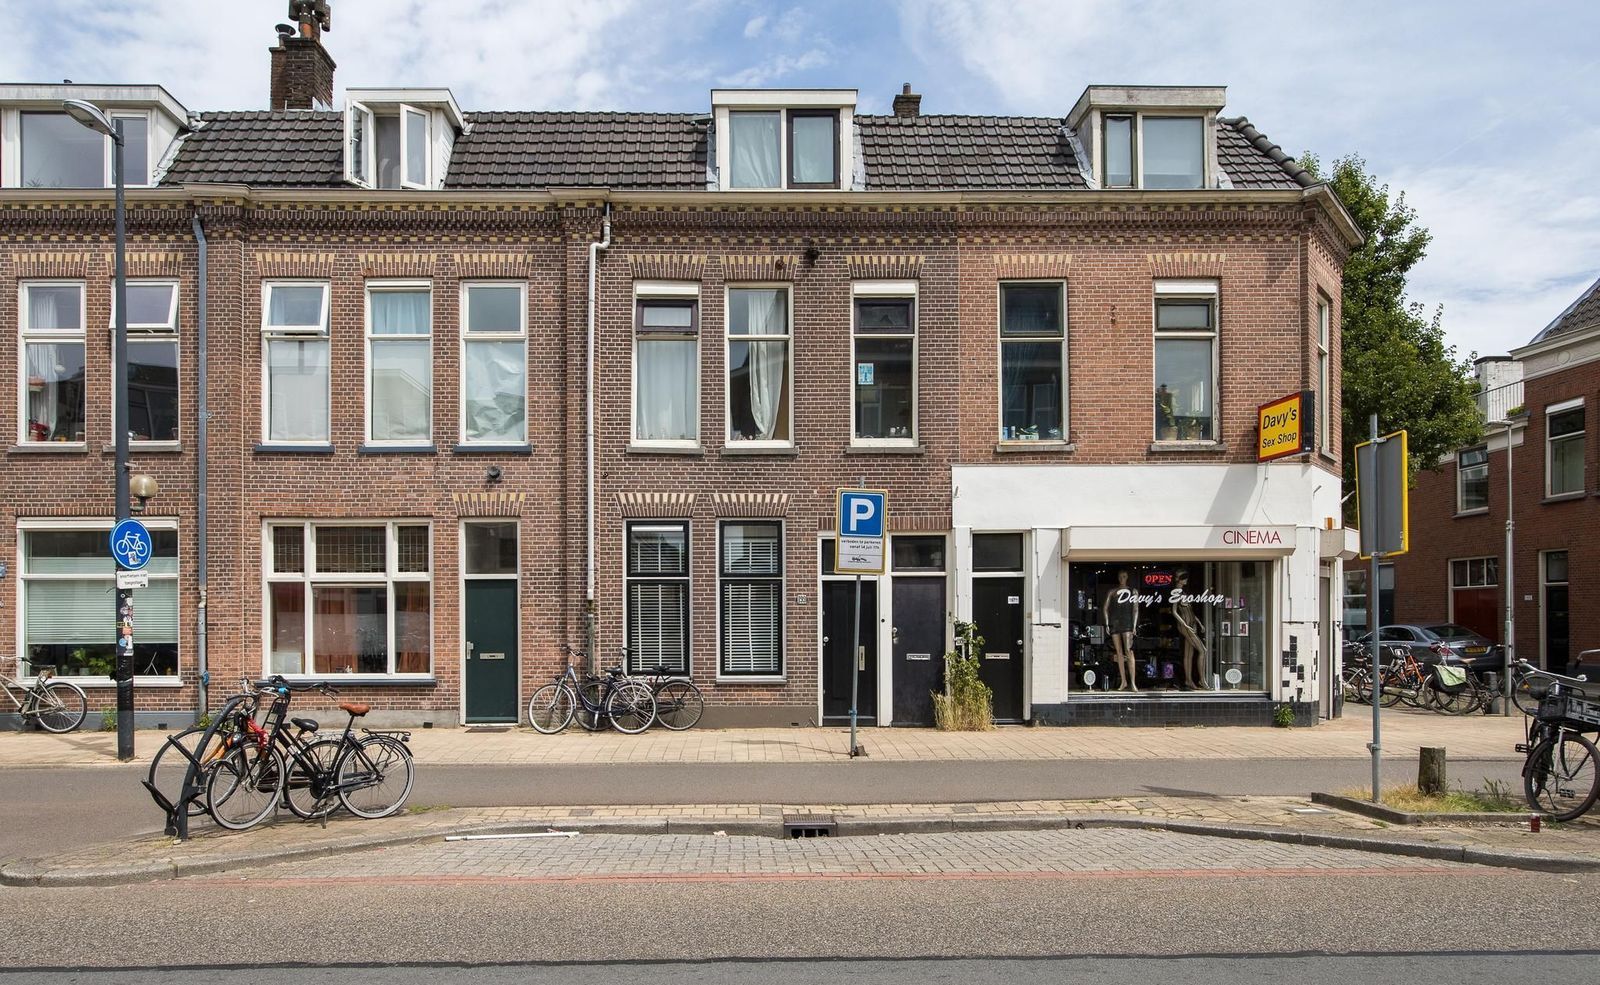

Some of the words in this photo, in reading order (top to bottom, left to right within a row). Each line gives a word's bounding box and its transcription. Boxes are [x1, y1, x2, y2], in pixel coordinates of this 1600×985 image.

[1263, 407, 1297, 430] Davy's
[1262, 438, 1276, 448] Sex
[1277, 432, 1297, 445] Shop
[850, 497, 875, 532] P
[1223, 530, 1282, 544] CINEMA
[1144, 574, 1173, 583] OPEN
[1116, 588, 1162, 607] Davy's
[1168, 588, 1224, 606] Eroshop
